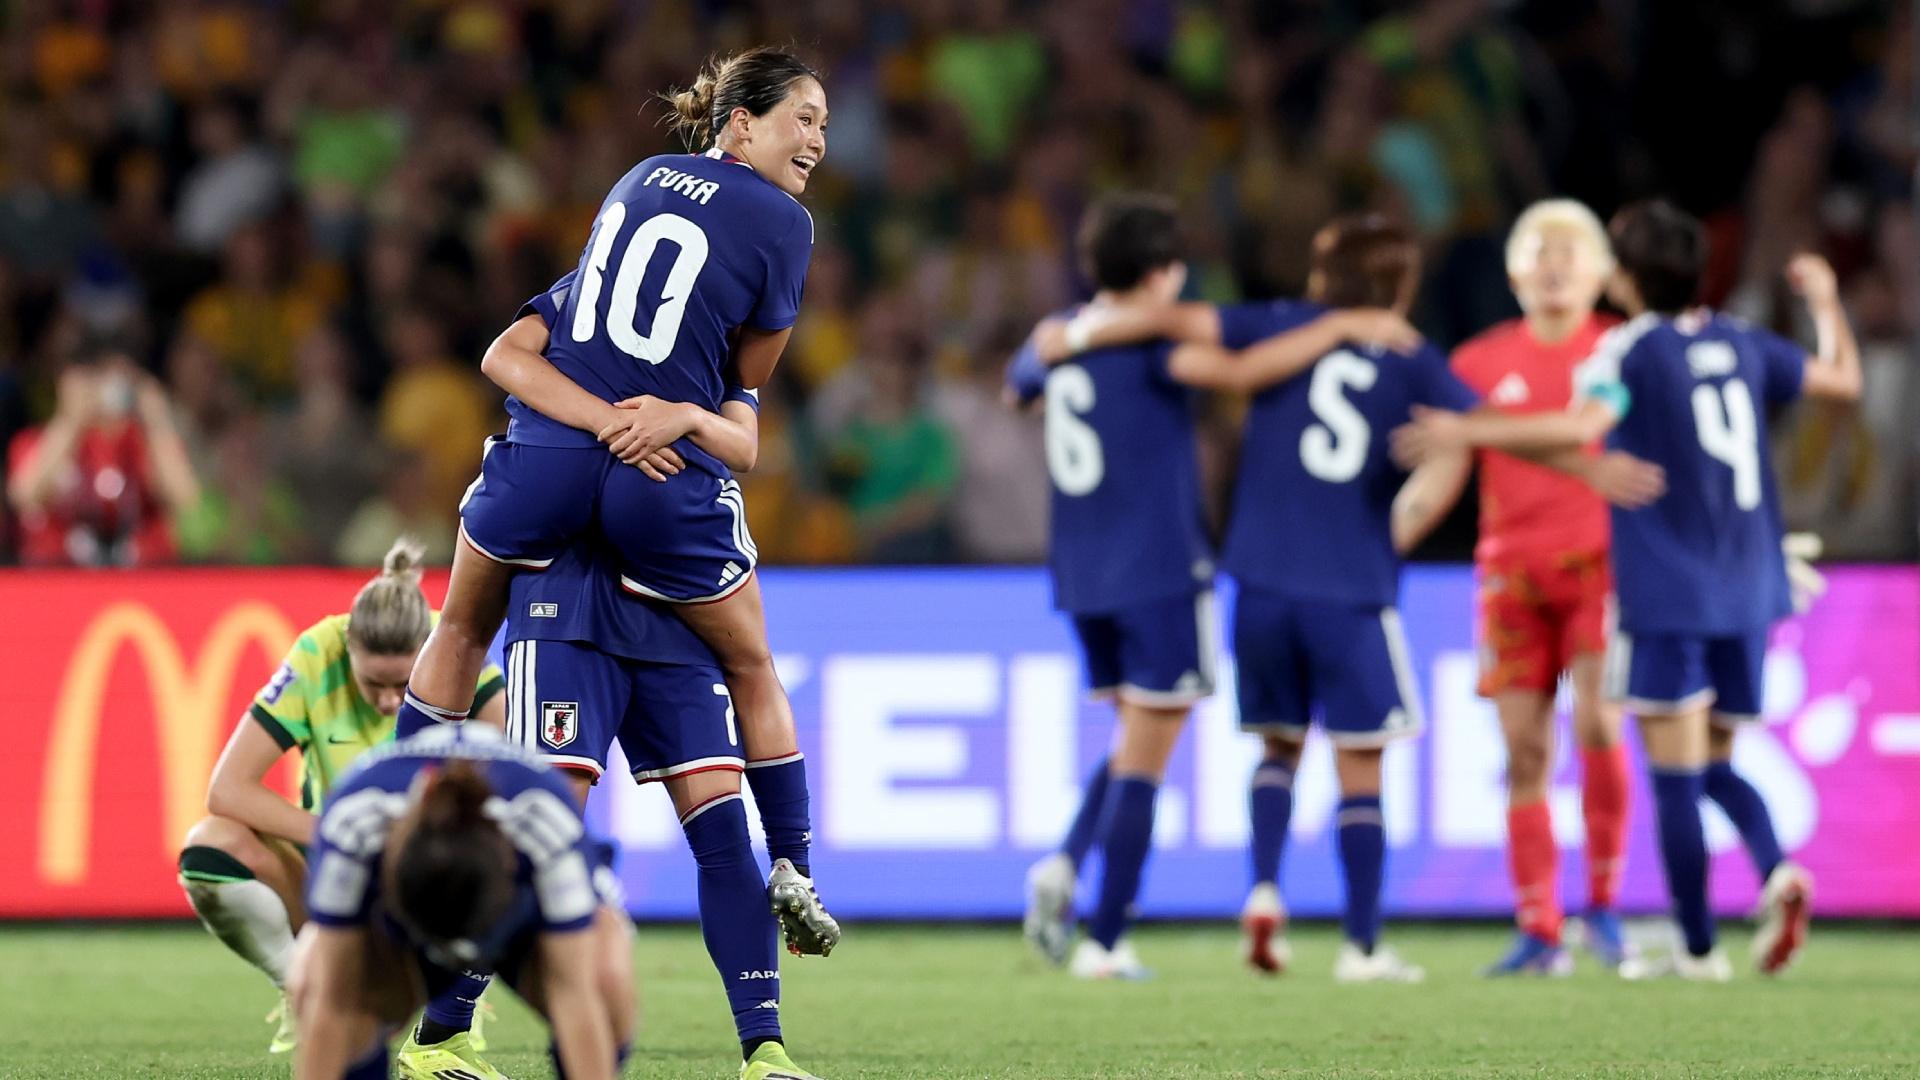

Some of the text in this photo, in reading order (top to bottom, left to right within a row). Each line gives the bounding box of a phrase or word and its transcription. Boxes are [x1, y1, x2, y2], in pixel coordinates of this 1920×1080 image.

[643, 167, 720, 205] FUKA
[572, 202, 709, 366] 10
[1045, 364, 1104, 496] 6
[1299, 350, 1378, 483] 5
[1691, 378, 1761, 512] 4
[713, 683, 738, 747] 7
